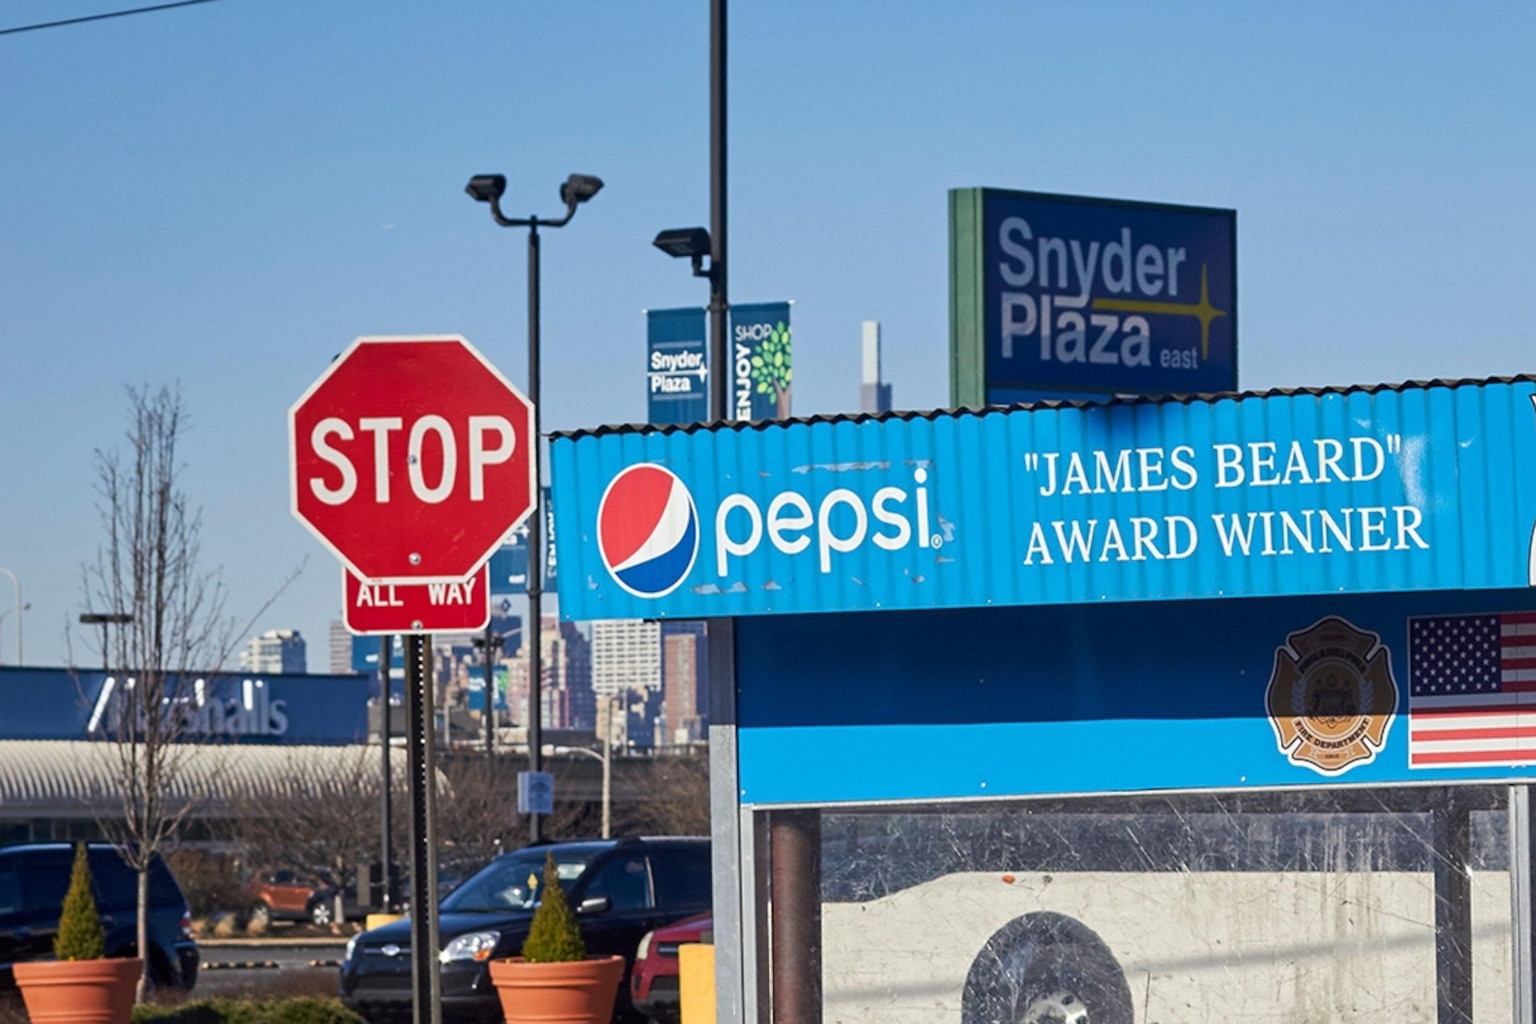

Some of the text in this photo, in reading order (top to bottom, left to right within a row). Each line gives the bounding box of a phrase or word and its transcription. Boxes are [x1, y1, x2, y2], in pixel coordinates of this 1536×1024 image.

[999, 216, 1186, 308] Snyder
[735, 323, 773, 341] SHOP
[1001, 291, 1198, 369] Plaza east
[651, 350, 703, 372] Snyder
[651, 375, 691, 393] Plaza
[736, 343, 751, 421] ENJOY
[310, 414, 516, 505] STOP
[1024, 434, 1401, 496] "JAMES BEARD"
[715, 467, 930, 577] pepsi
[1023, 505, 1430, 565] AWARD WINNER
[356, 577, 477, 607] ALL WAY
[1294, 719, 1370, 749] FIRE DEPARTMENT
